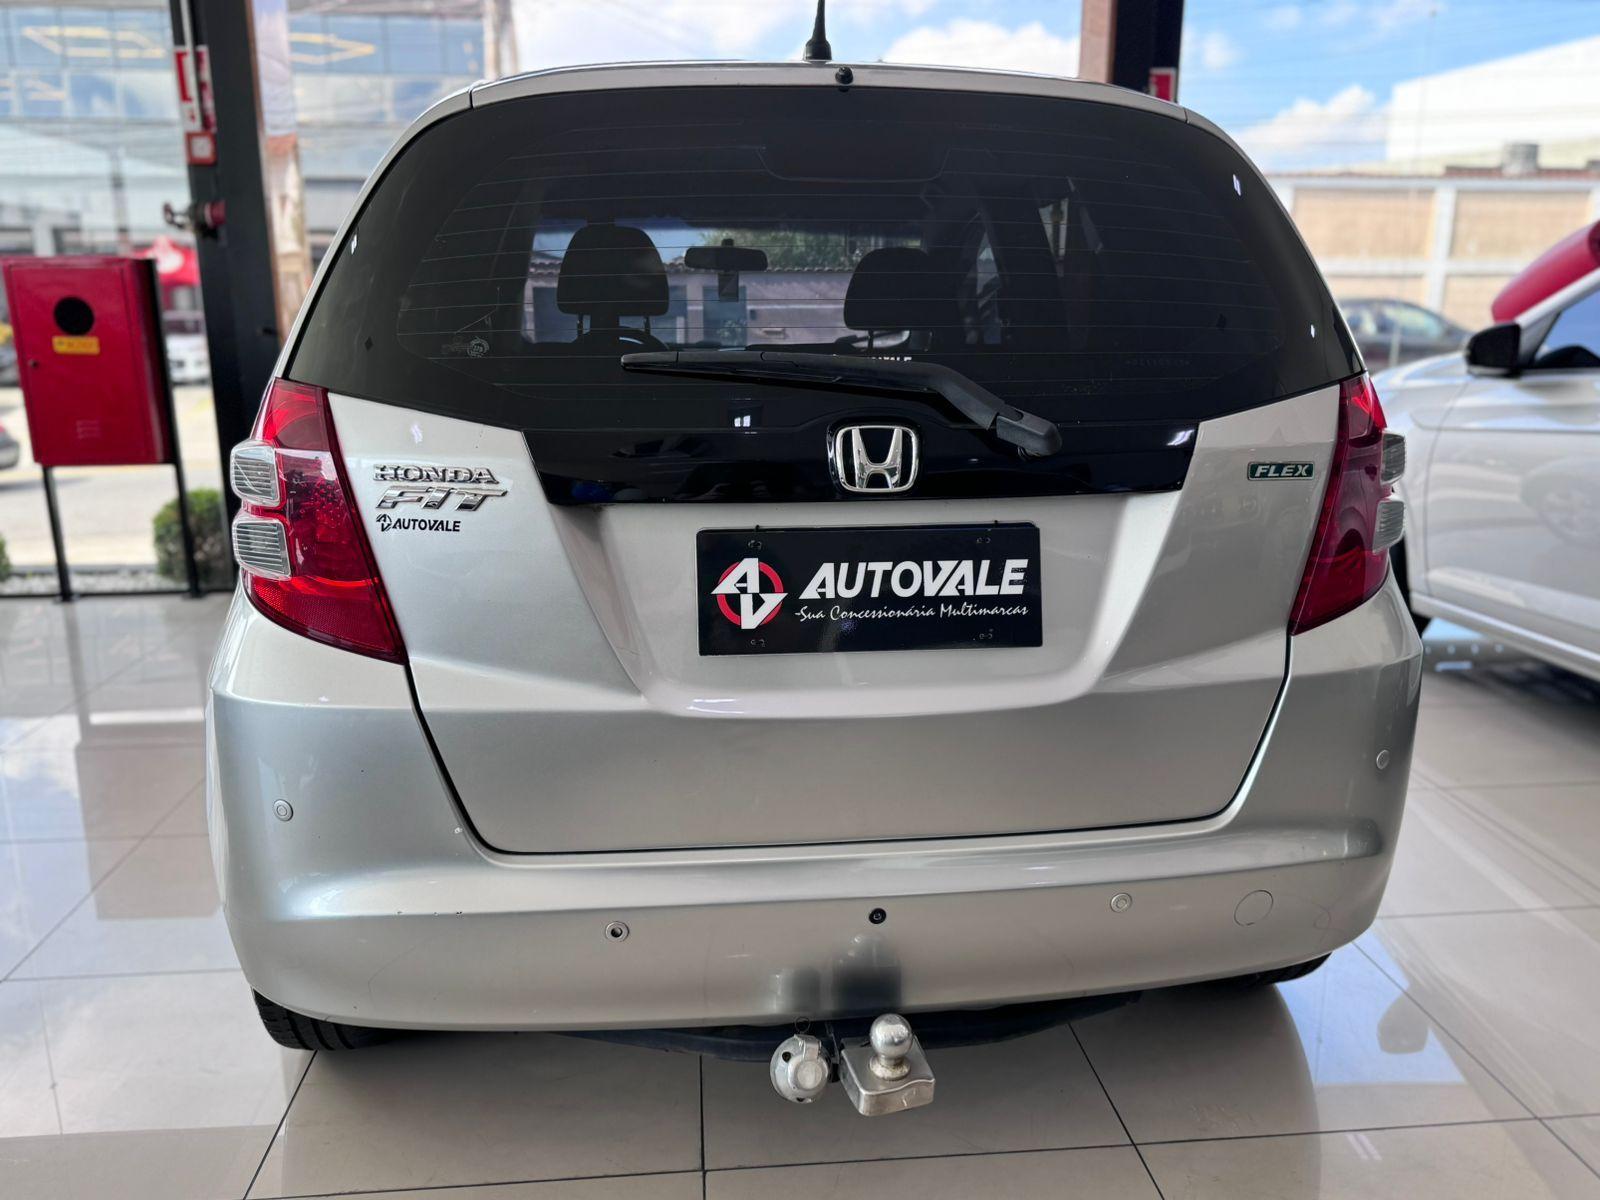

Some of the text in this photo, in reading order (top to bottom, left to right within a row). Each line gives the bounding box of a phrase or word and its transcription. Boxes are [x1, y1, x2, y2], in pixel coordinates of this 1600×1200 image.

[373, 464, 499, 485] HONDA
[1254, 464, 1310, 478] FLEX
[376, 485, 508, 512] FIT
[392, 518, 462, 532] AUTOVALE
[798, 558, 1029, 600] AUTOVALE
[829, 605, 936, 621] Concessionária
[939, 602, 1029, 618] Multimarcas
